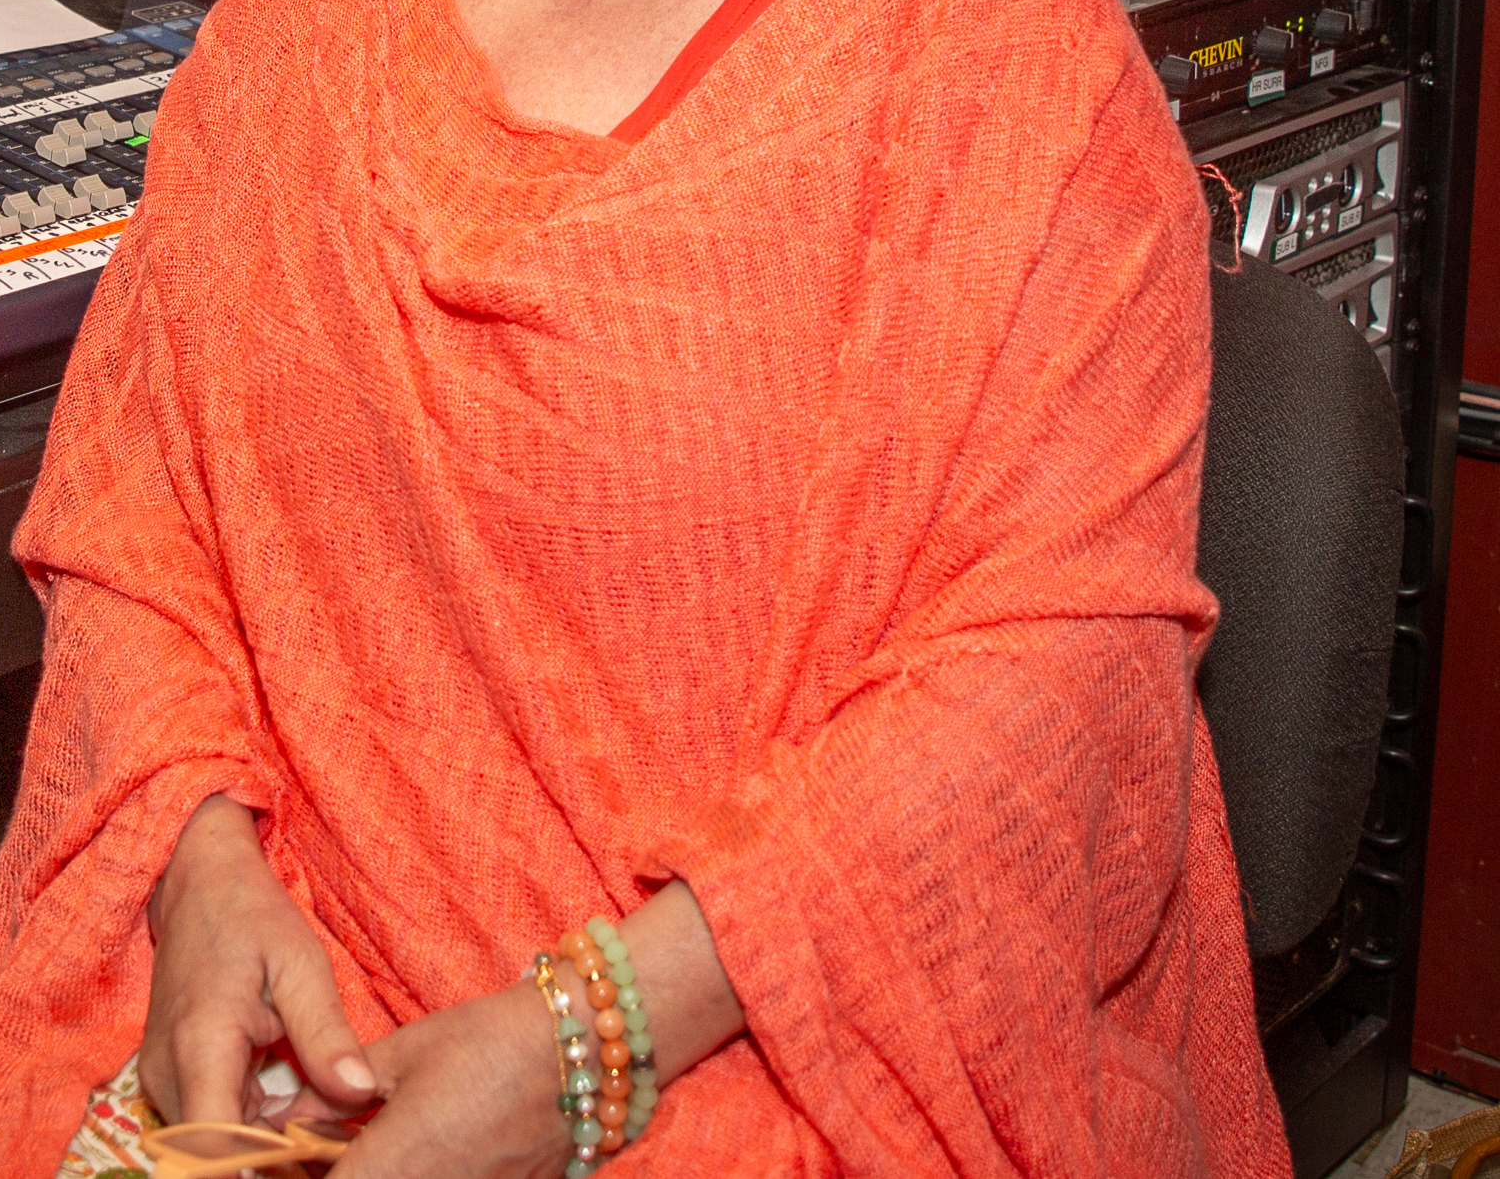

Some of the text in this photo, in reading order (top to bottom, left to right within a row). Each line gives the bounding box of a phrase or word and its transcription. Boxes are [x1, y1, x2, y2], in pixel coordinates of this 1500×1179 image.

[1314, 57, 1329, 70] NFG
[1252, 75, 1283, 93] HR SURR
[1277, 240, 1290, 255] SUB
